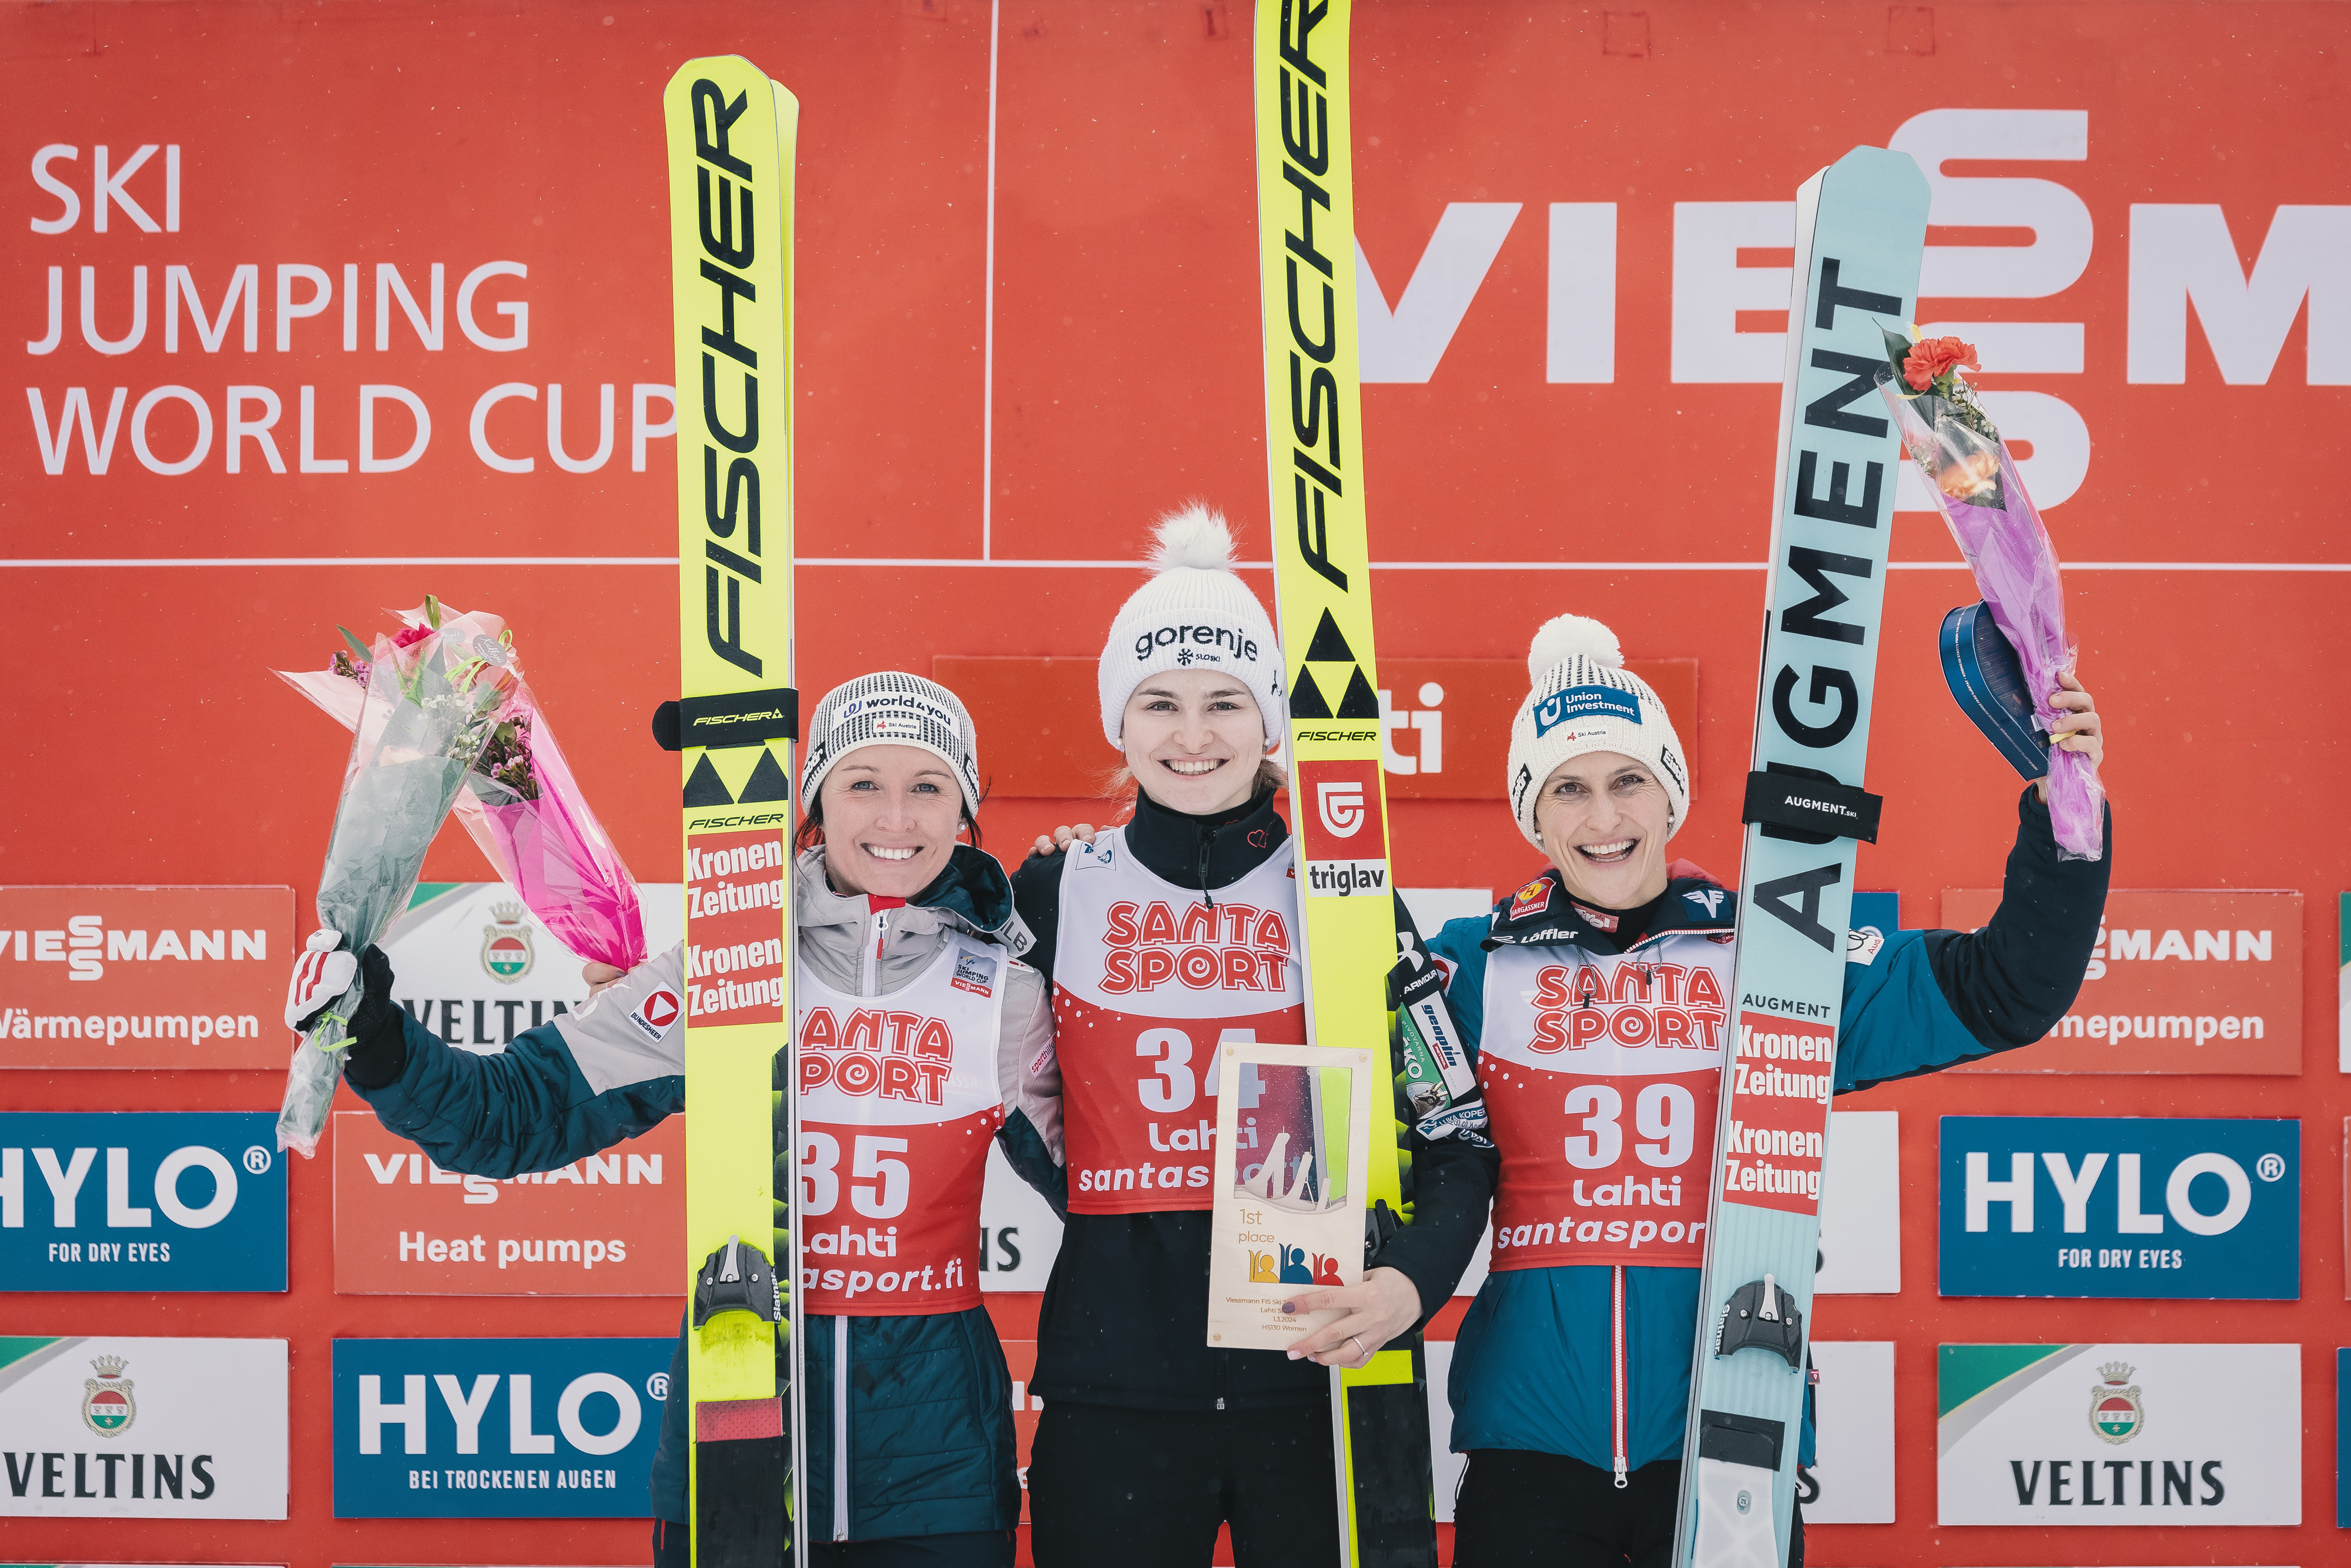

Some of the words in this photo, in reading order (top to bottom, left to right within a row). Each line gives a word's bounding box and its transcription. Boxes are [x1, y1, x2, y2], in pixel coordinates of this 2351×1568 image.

[30, 143, 180, 234] SKI
[27, 260, 529, 356] JUMPING
[1279, 0, 1349, 594] FISCHER
[691, 78, 763, 679] FISCHER
[26, 384, 431, 475] WORLD
[468, 381, 679, 473] CUP
[1135, 625, 1258, 662] gorenje
[1958, 658, 1966, 678] KINDNESS
[866, 695, 952, 726] world4you
[1566, 691, 1602, 704] Union
[1566, 701, 1635, 717] Investment
[693, 710, 773, 726] FISCHER
[1297, 731, 1377, 741] FISCHER
[689, 813, 784, 830] FISCHER
[688, 840, 783, 881] Kronen
[1310, 862, 1384, 897] triglav
[688, 878, 783, 919] Zeitung
[1103, 900, 1291, 956] SANTA
[1867, 937, 1883, 955] Audi
[688, 937, 783, 978] Kronen
[957, 969, 989, 981] JUMPING
[1098, 944, 1289, 994] SPORT
[955, 980, 989, 995] VIESSMANN
[956, 972, 976, 981] WORLD
[1404, 969, 1437, 994] ARMOUR
[1530, 960, 1726, 1009] SANTA
[688, 975, 783, 1017] Zeitung
[1742, 993, 1831, 1019] AUGMENT
[0, 1009, 259, 1045] ärmepumpen
[630, 1012, 662, 1040] BUNDESHEER
[799, 1006, 954, 1063] ANTA
[1402, 1020, 1425, 1063] PIVOVARNA
[1421, 1004, 1461, 1066] geoplin
[1527, 1006, 1728, 1053] SPORT
[1737, 1024, 1833, 1063] Kronen
[1032, 1041, 1055, 1074] sporthilfe
[1136, 1027, 1267, 1114] 34
[1435, 1046, 1446, 1068] PETROL
[1735, 1063, 1831, 1104] Zeitung
[1459, 1107, 1486, 1119] KOPER
[1563, 1083, 1694, 1170] 39
[1727, 1120, 1823, 1158] Kronen
[1573, 1175, 1682, 1207] Lahti
[1725, 1159, 1821, 1200] Zeitung
[1240, 1208, 1262, 1225] 1st
[49, 1242, 81, 1262] FOR
[88, 1242, 121, 1262] DRY
[128, 1242, 171, 1262] EYES
[399, 1231, 485, 1262] Heat
[498, 1238, 627, 1269] pumps
[1238, 1231, 1275, 1244] place
[2058, 1248, 2092, 1269] FOR
[2098, 1248, 2133, 1269] DRY
[2139, 1248, 2183, 1269] EYES
[2, 1452, 216, 1500] VELTINS
[409, 1469, 438, 1490] BEI
[445, 1469, 550, 1490] TROCKENEN
[557, 1469, 616, 1490] AUGEN
[2010, 1459, 2226, 1507] VELTINS
